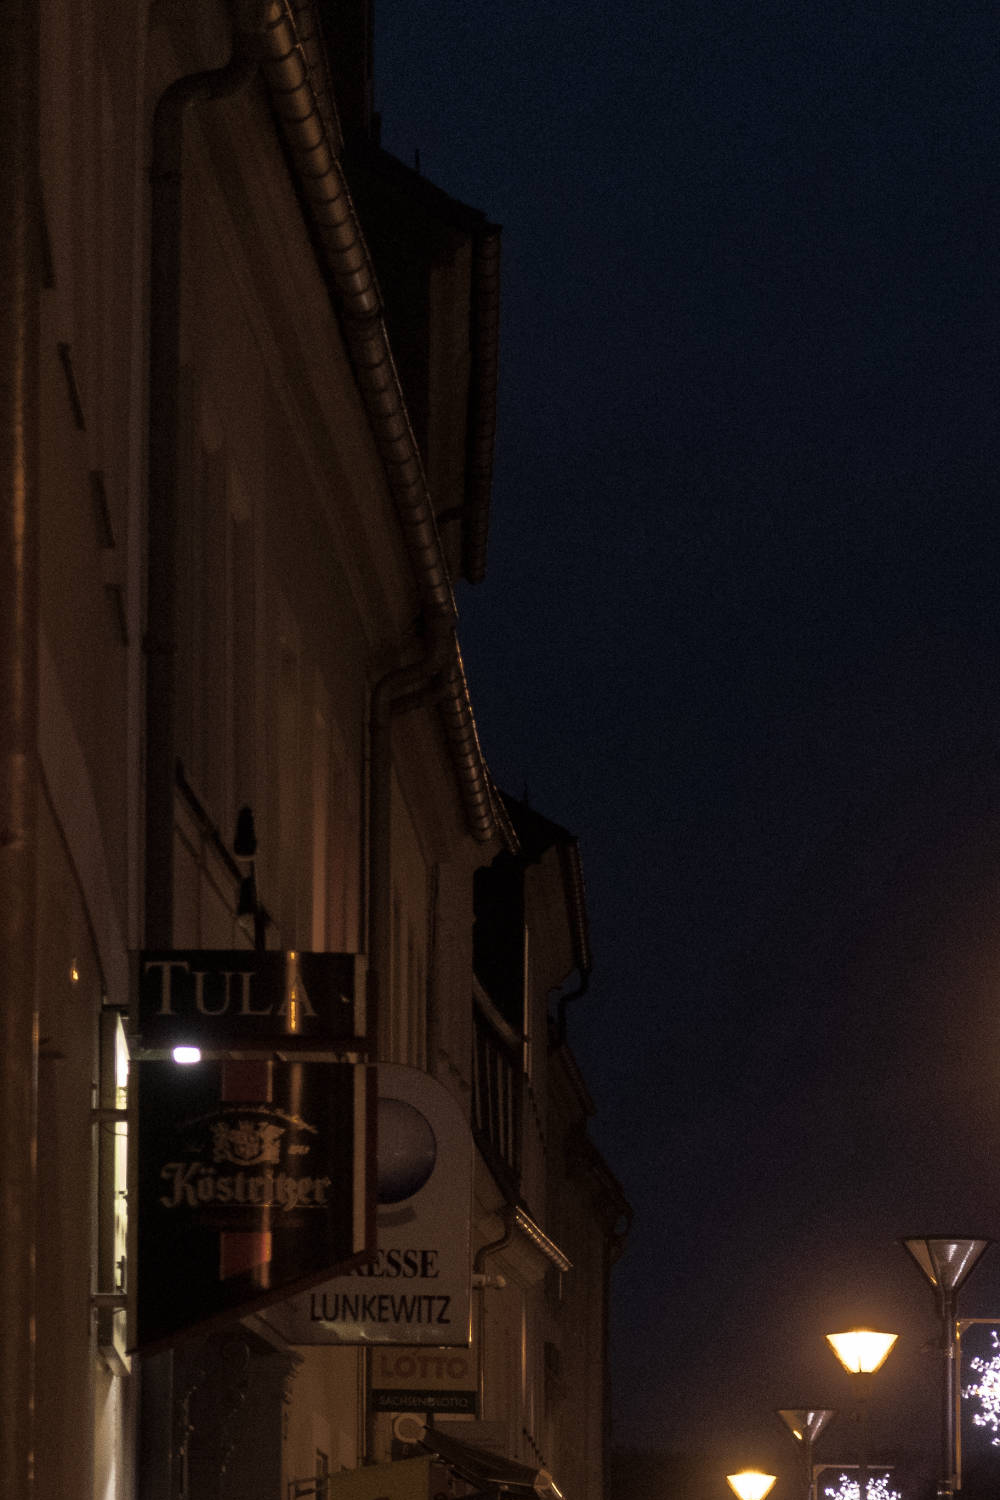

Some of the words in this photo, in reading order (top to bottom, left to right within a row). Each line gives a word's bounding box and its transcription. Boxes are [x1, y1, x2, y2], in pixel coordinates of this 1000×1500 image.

[143, 960, 320, 1017] TULA
[346, 1248, 440, 1279] ESSE
[310, 1293, 452, 1324] LUNKEWITZ
[379, 1355, 469, 1379] LOTTO
